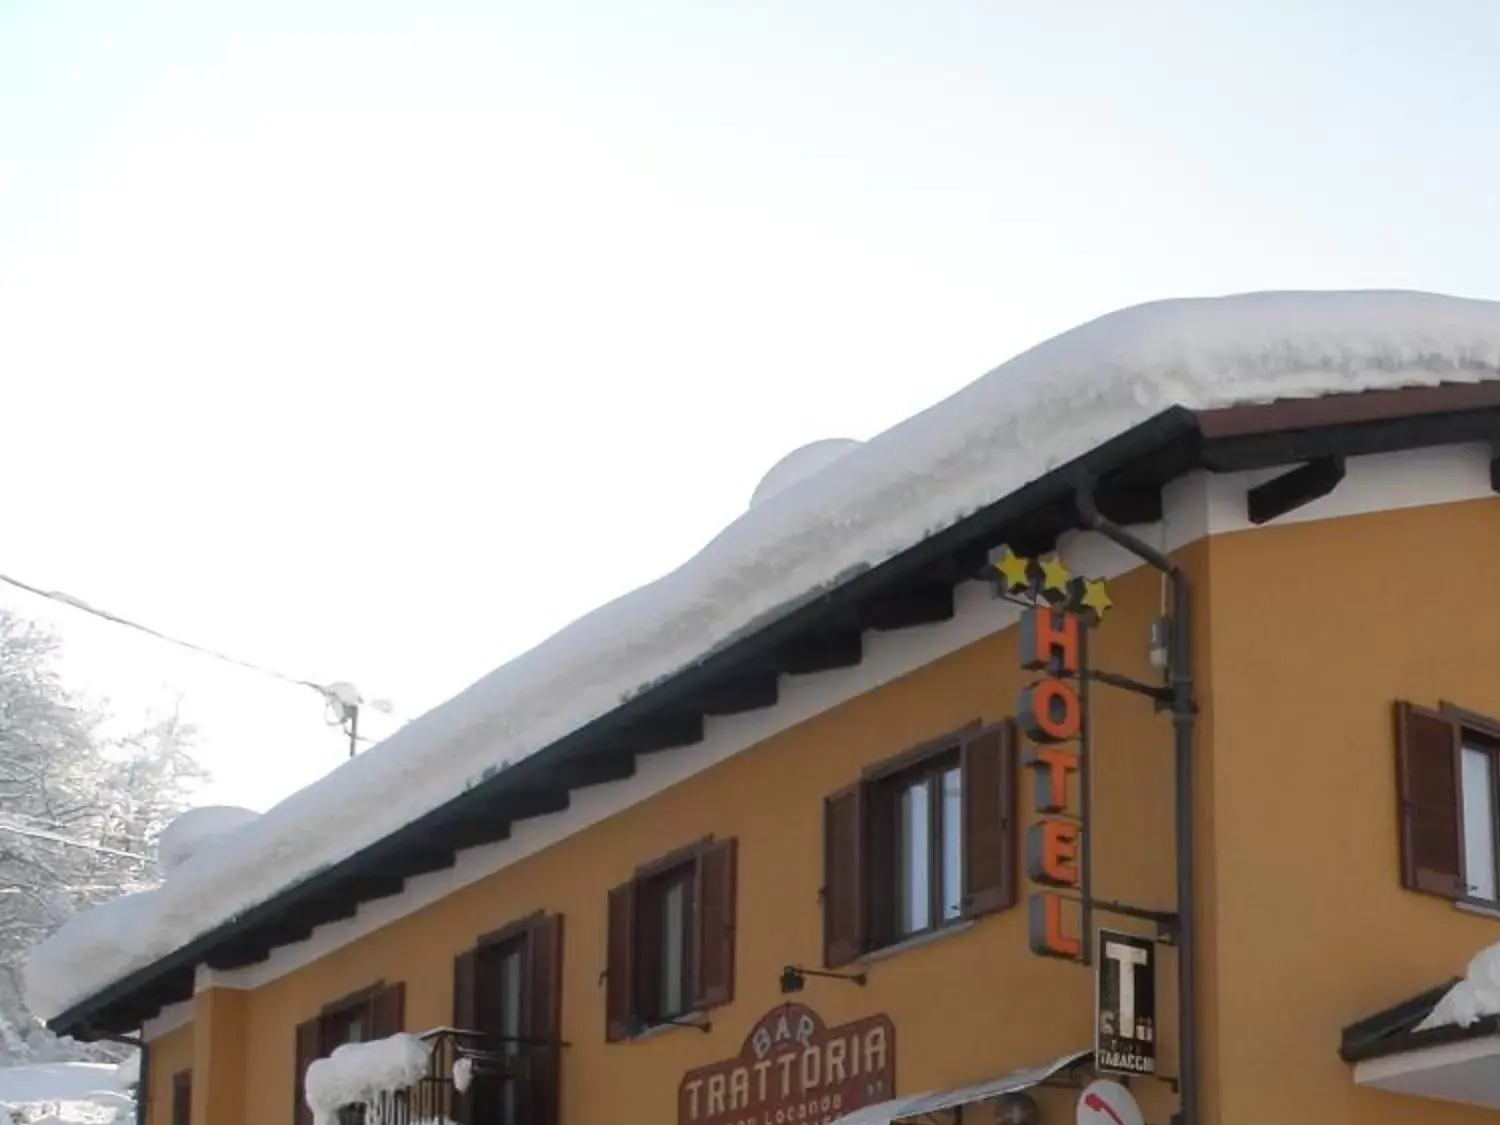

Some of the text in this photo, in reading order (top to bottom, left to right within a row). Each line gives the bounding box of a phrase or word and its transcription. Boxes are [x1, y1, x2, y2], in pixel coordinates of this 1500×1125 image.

[1031, 603, 1082, 960] HOTEL
[752, 1014, 815, 1058] BAR
[1105, 942, 1148, 1039] T
[684, 1026, 887, 1120] TRATTORIA
